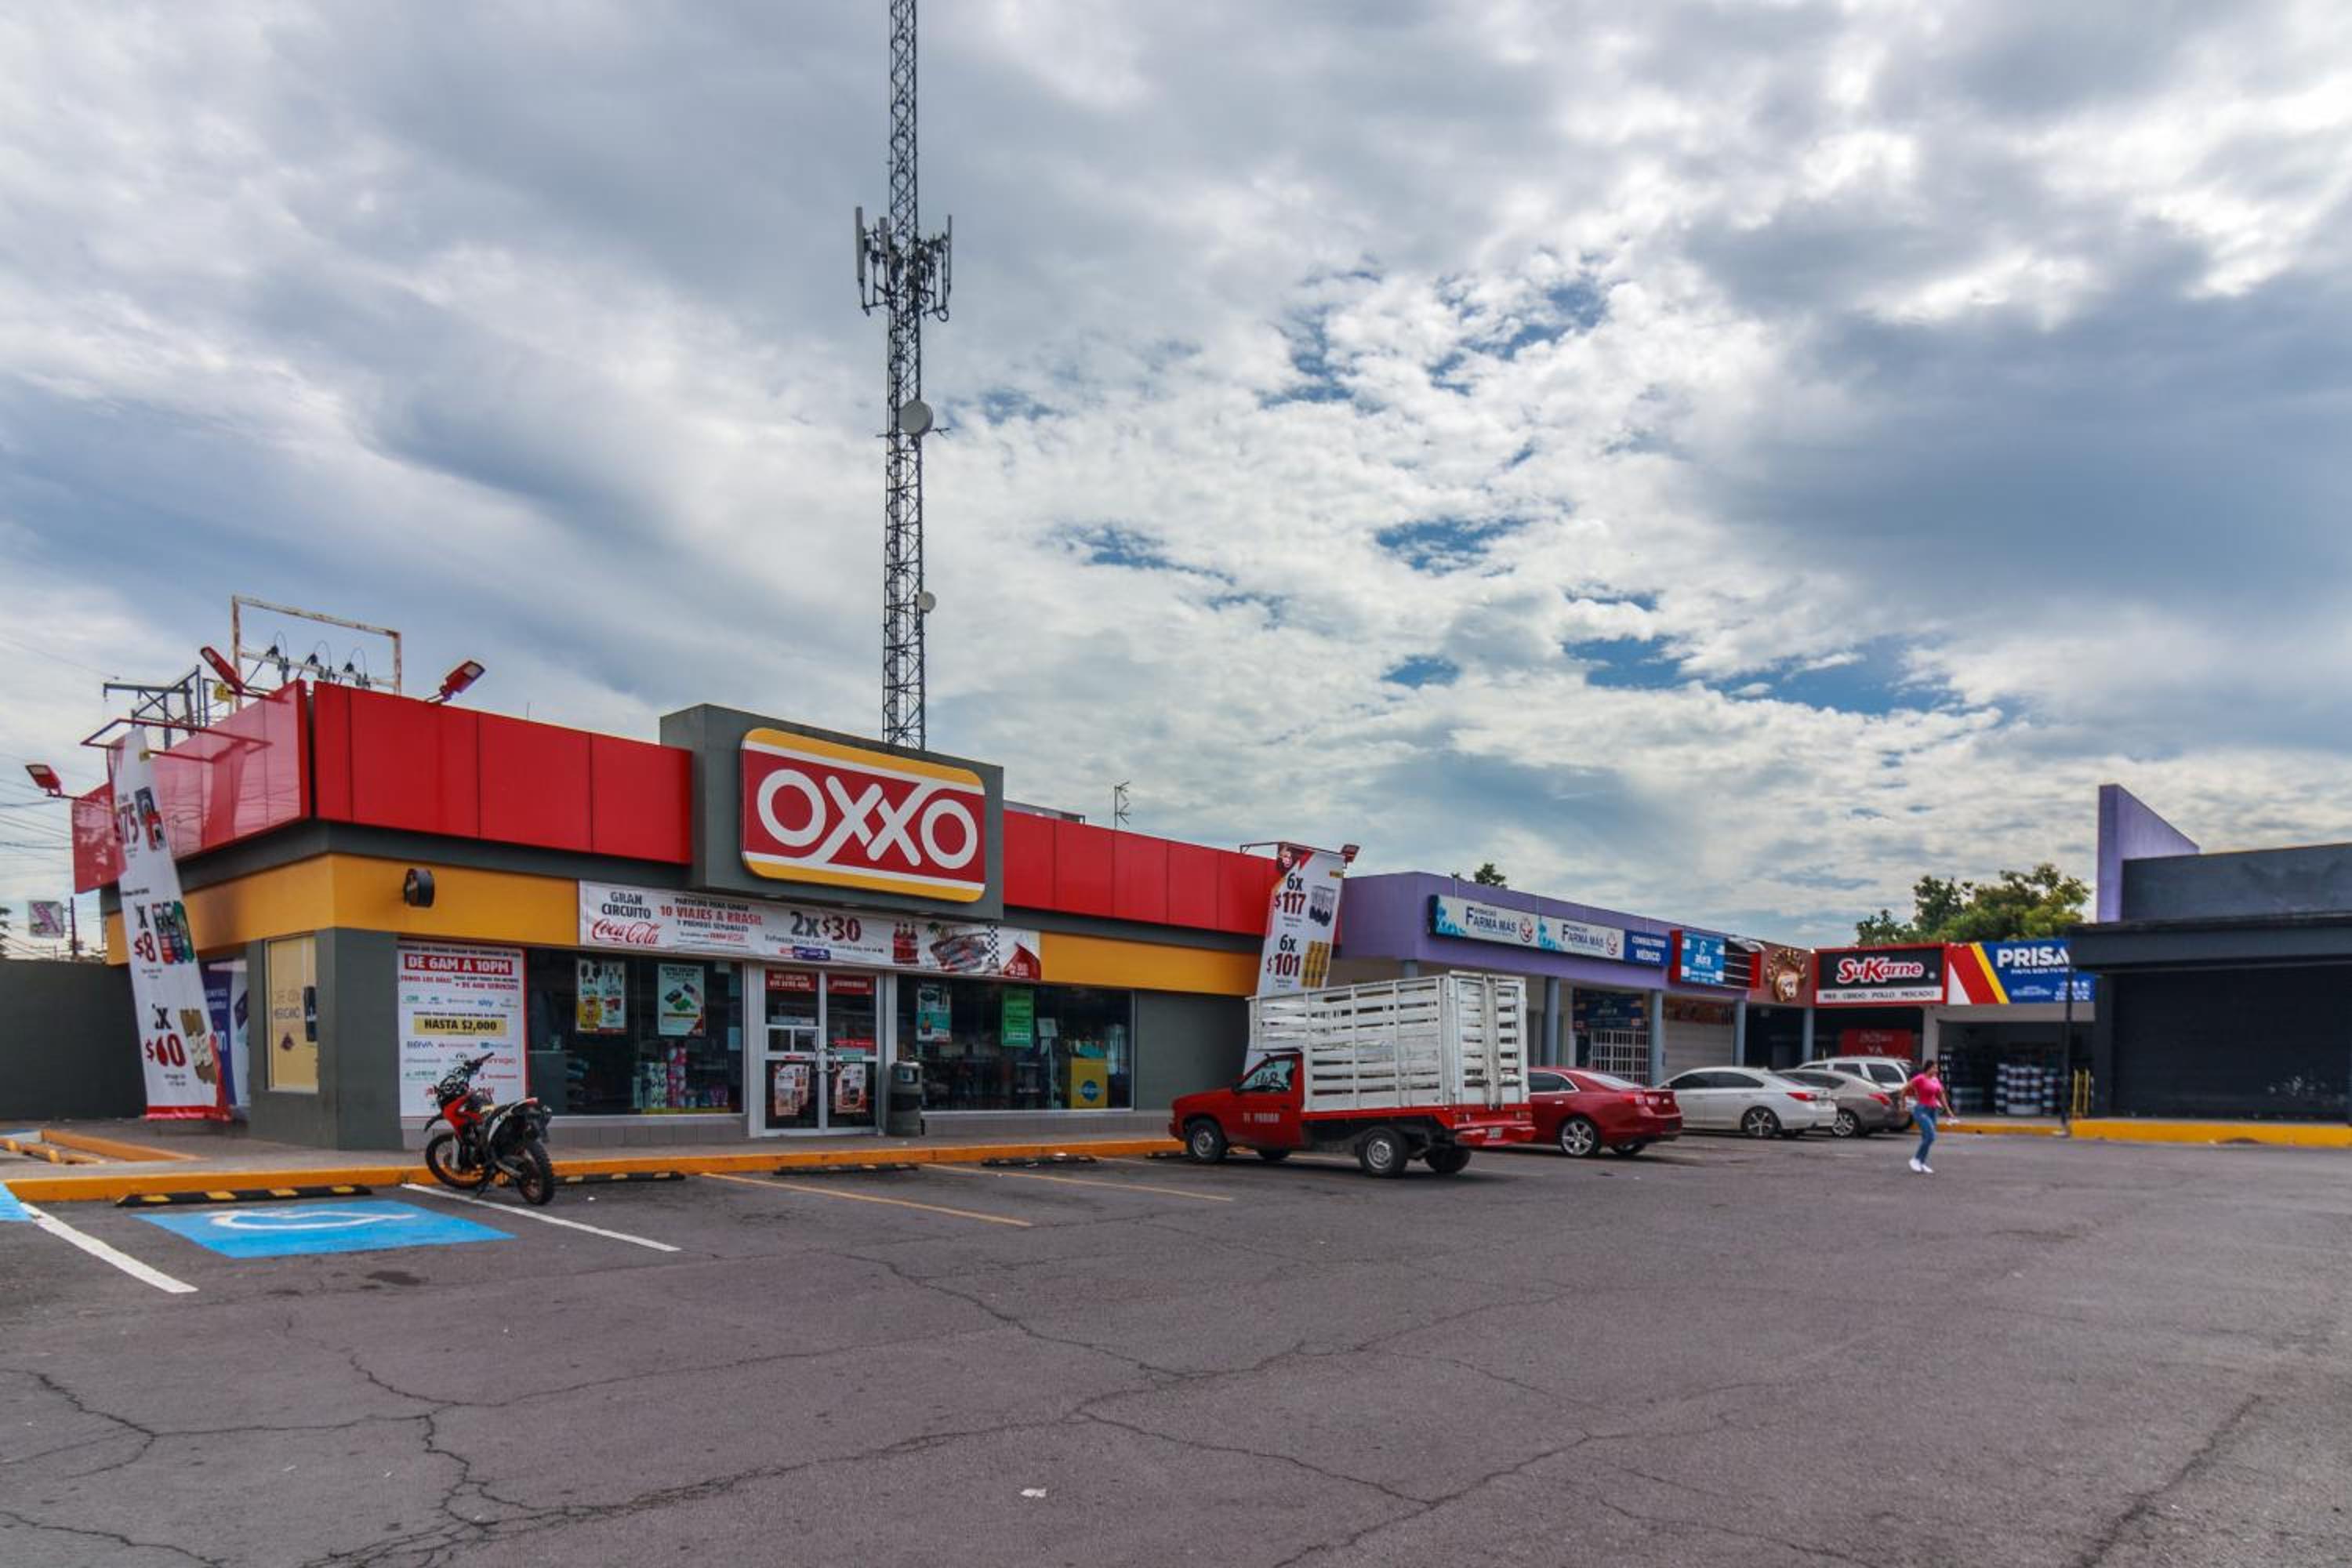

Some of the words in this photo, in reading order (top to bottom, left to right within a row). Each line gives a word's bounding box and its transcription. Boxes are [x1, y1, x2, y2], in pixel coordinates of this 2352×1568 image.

[757, 769, 978, 869] OXXO
[1287, 873, 1303, 891] 6x
[610, 891, 642, 906] GRAN
[1275, 891, 1306, 915] $117
[601, 903, 651, 919] CIRCUITO
[659, 906, 672, 916] 10
[677, 906, 712, 920] VIAJES
[717, 911, 723, 921] A
[728, 912, 762, 925] BRASIL
[1279, 934, 1297, 952] 6x
[408, 956, 425, 968] DE
[429, 957, 459, 971] 6AM
[463, 959, 472, 971] A
[476, 960, 509, 974] 10PM
[1266, 953, 1301, 977] $101
[1998, 946, 2070, 967] PRISA
[1838, 957, 1922, 983] SuKarne
[424, 1019, 458, 1029] HASTA
[462, 1020, 497, 1032] $2,000
